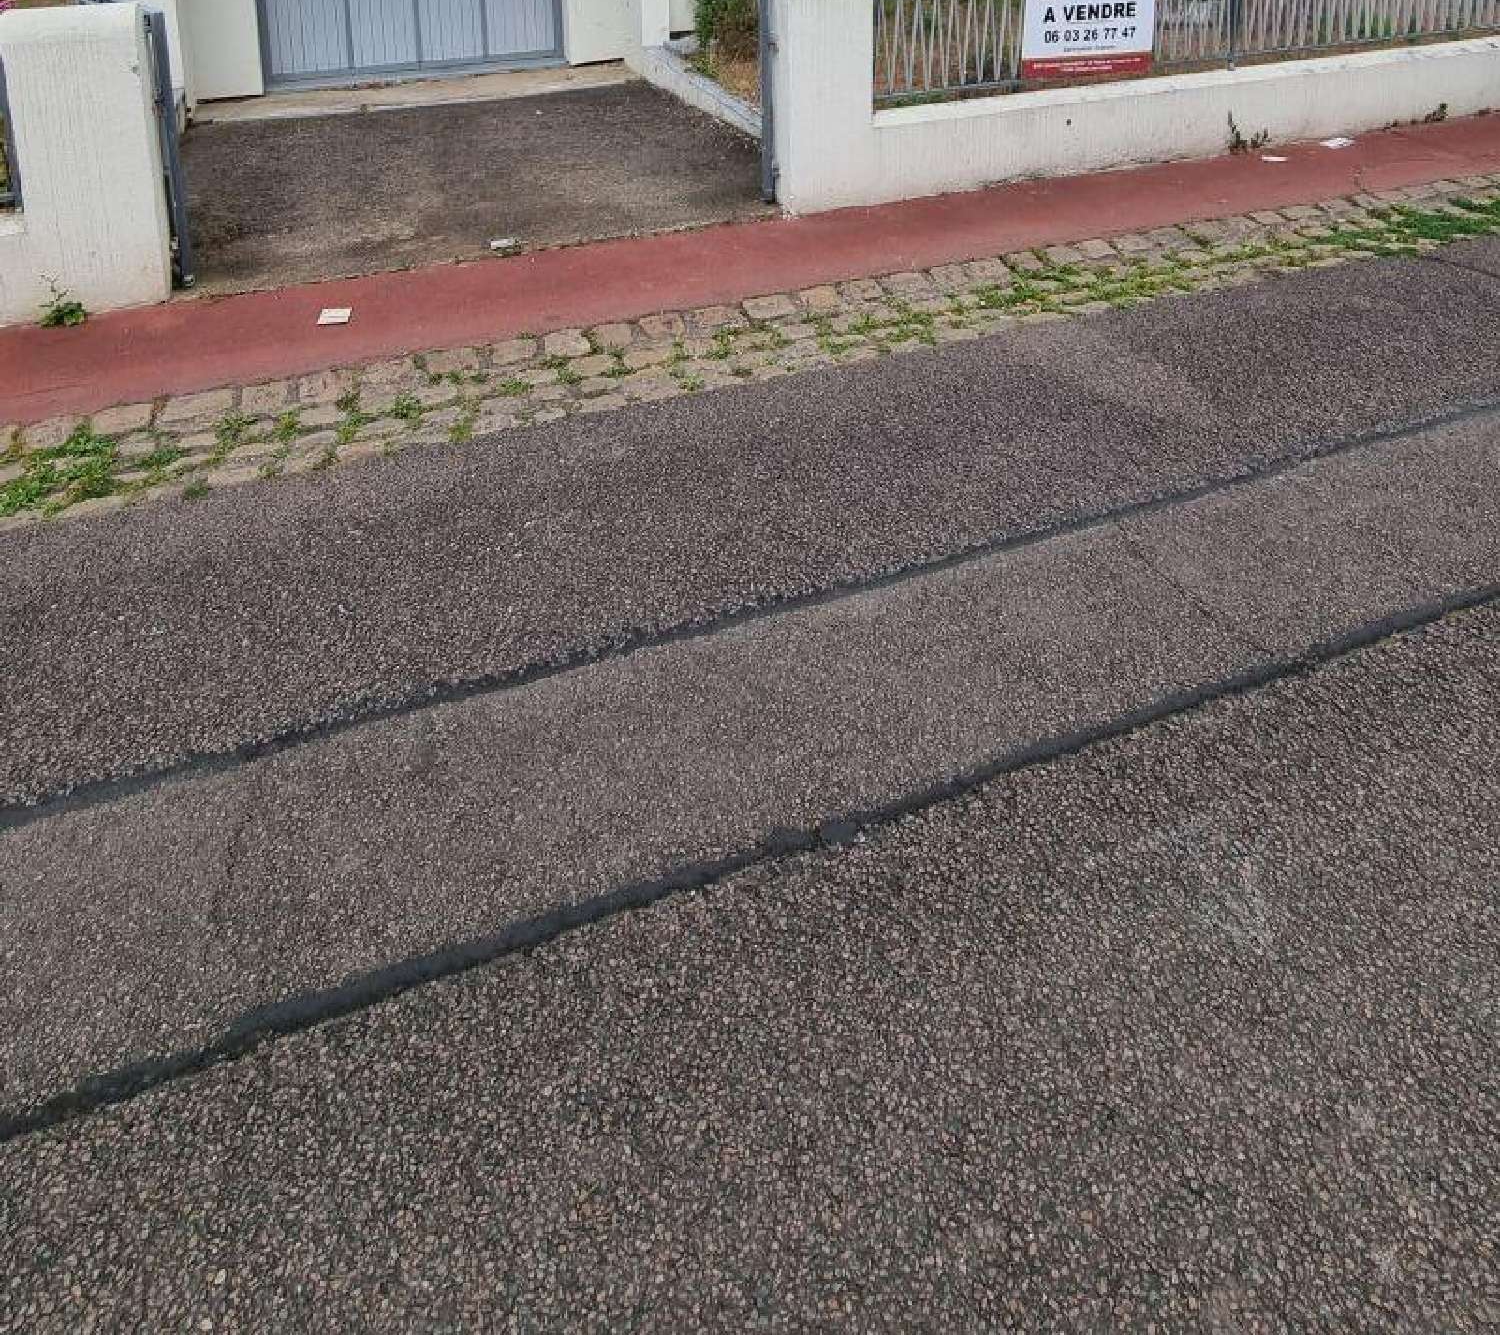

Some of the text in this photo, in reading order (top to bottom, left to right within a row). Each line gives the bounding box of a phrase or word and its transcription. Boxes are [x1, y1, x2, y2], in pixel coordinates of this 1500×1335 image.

[1043, 1, 1137, 23] A VENDRE
[1044, 26, 1136, 44] 06 03 26 77 47
